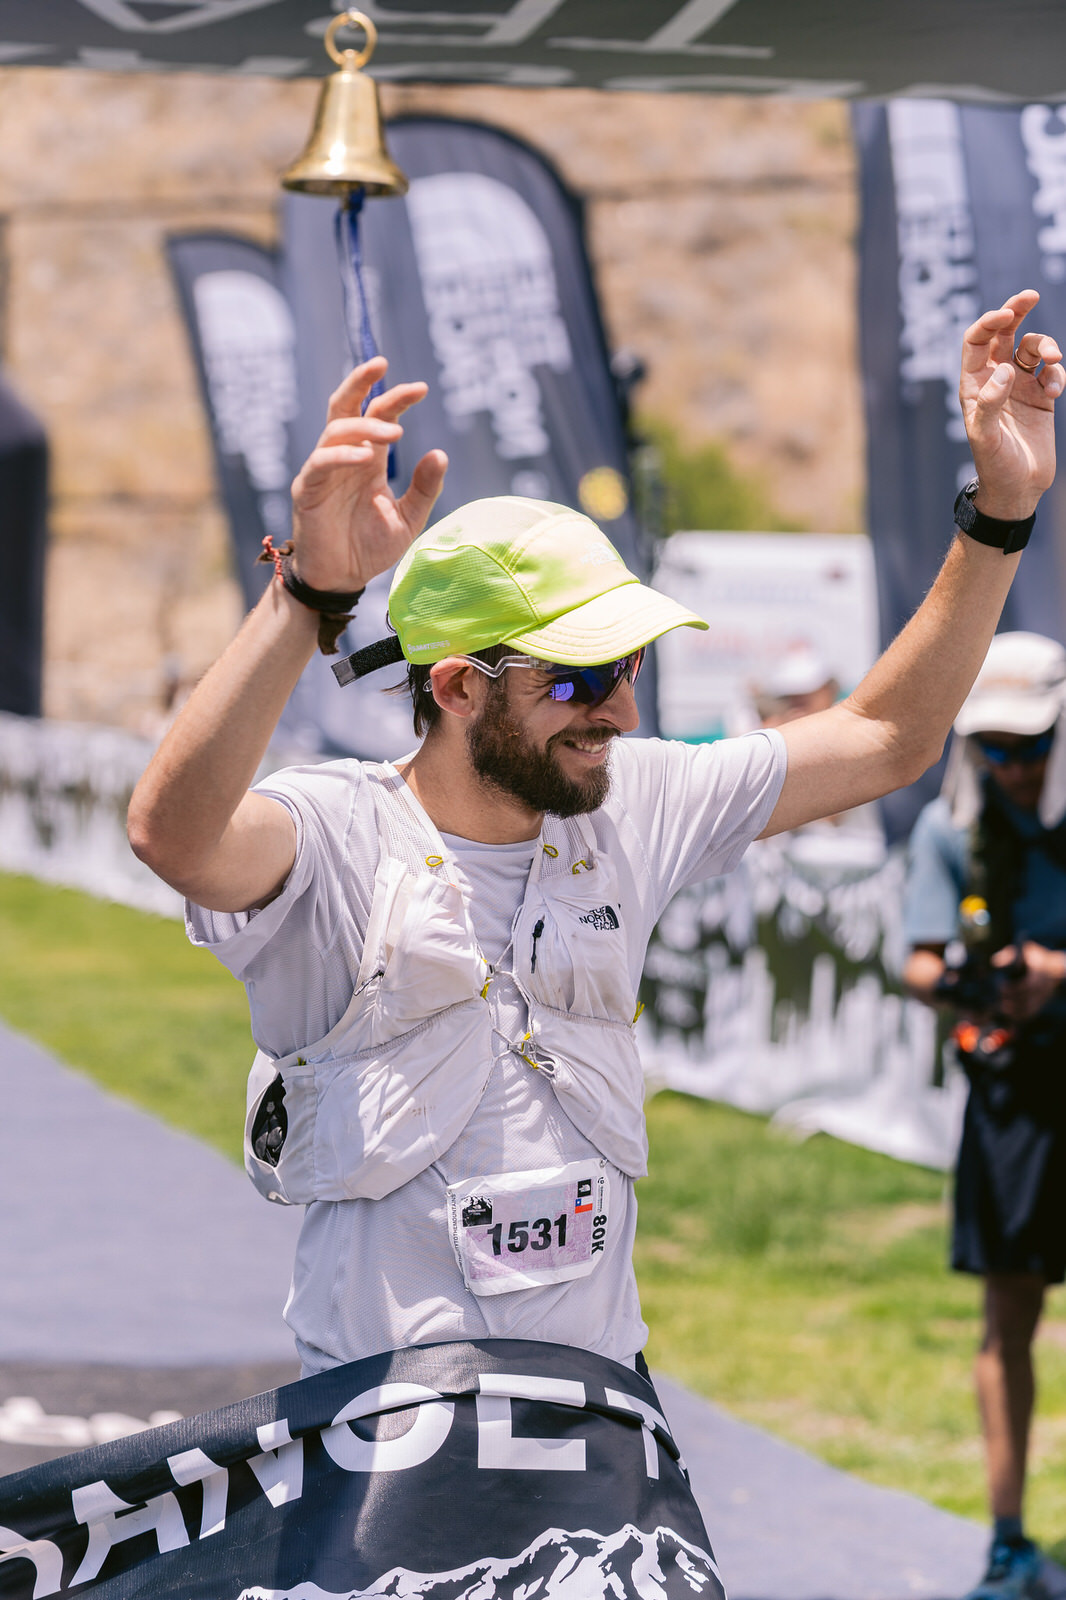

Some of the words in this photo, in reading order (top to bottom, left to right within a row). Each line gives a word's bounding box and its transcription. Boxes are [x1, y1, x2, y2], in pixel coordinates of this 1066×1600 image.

[579, 913, 606, 923] NORT
[593, 921, 614, 930] FACE
[487, 1214, 567, 1256] 1531
[591, 1215, 607, 1255] 80K
